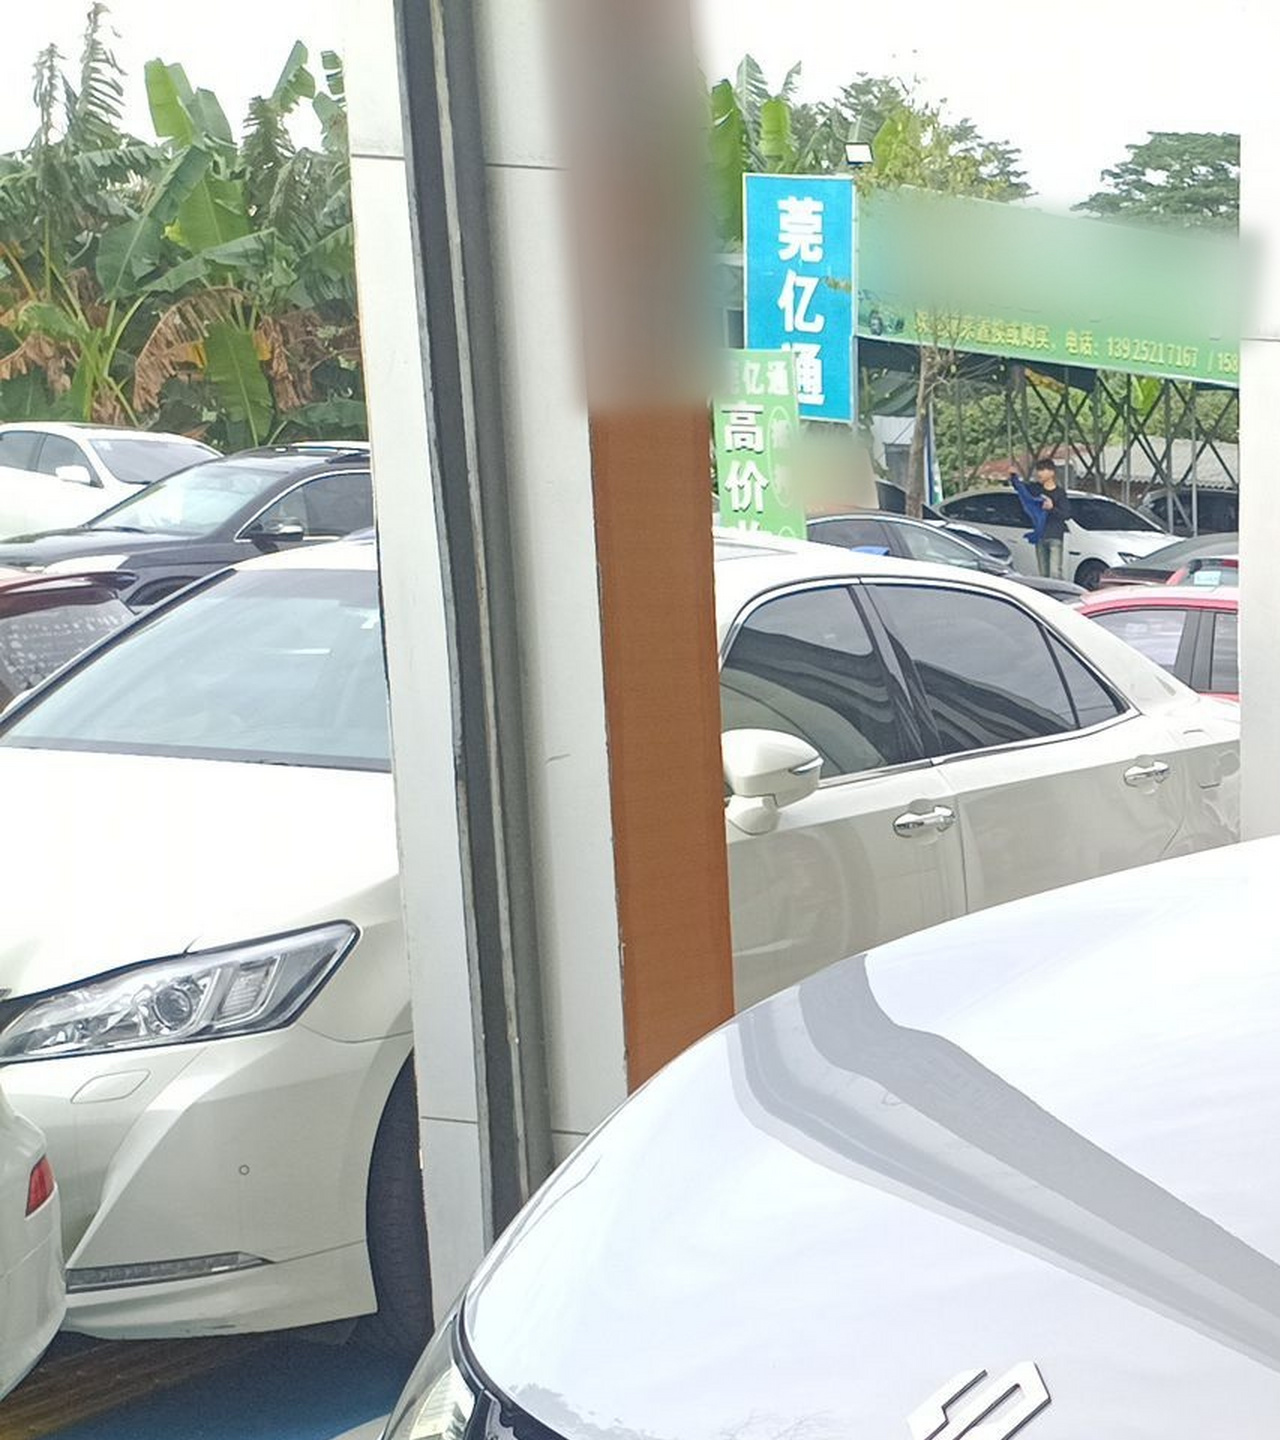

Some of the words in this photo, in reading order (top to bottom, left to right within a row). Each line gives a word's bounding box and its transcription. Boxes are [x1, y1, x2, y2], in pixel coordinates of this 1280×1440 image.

[777, 196, 825, 405] 莞亿通
[721, 400, 771, 532] 高价
